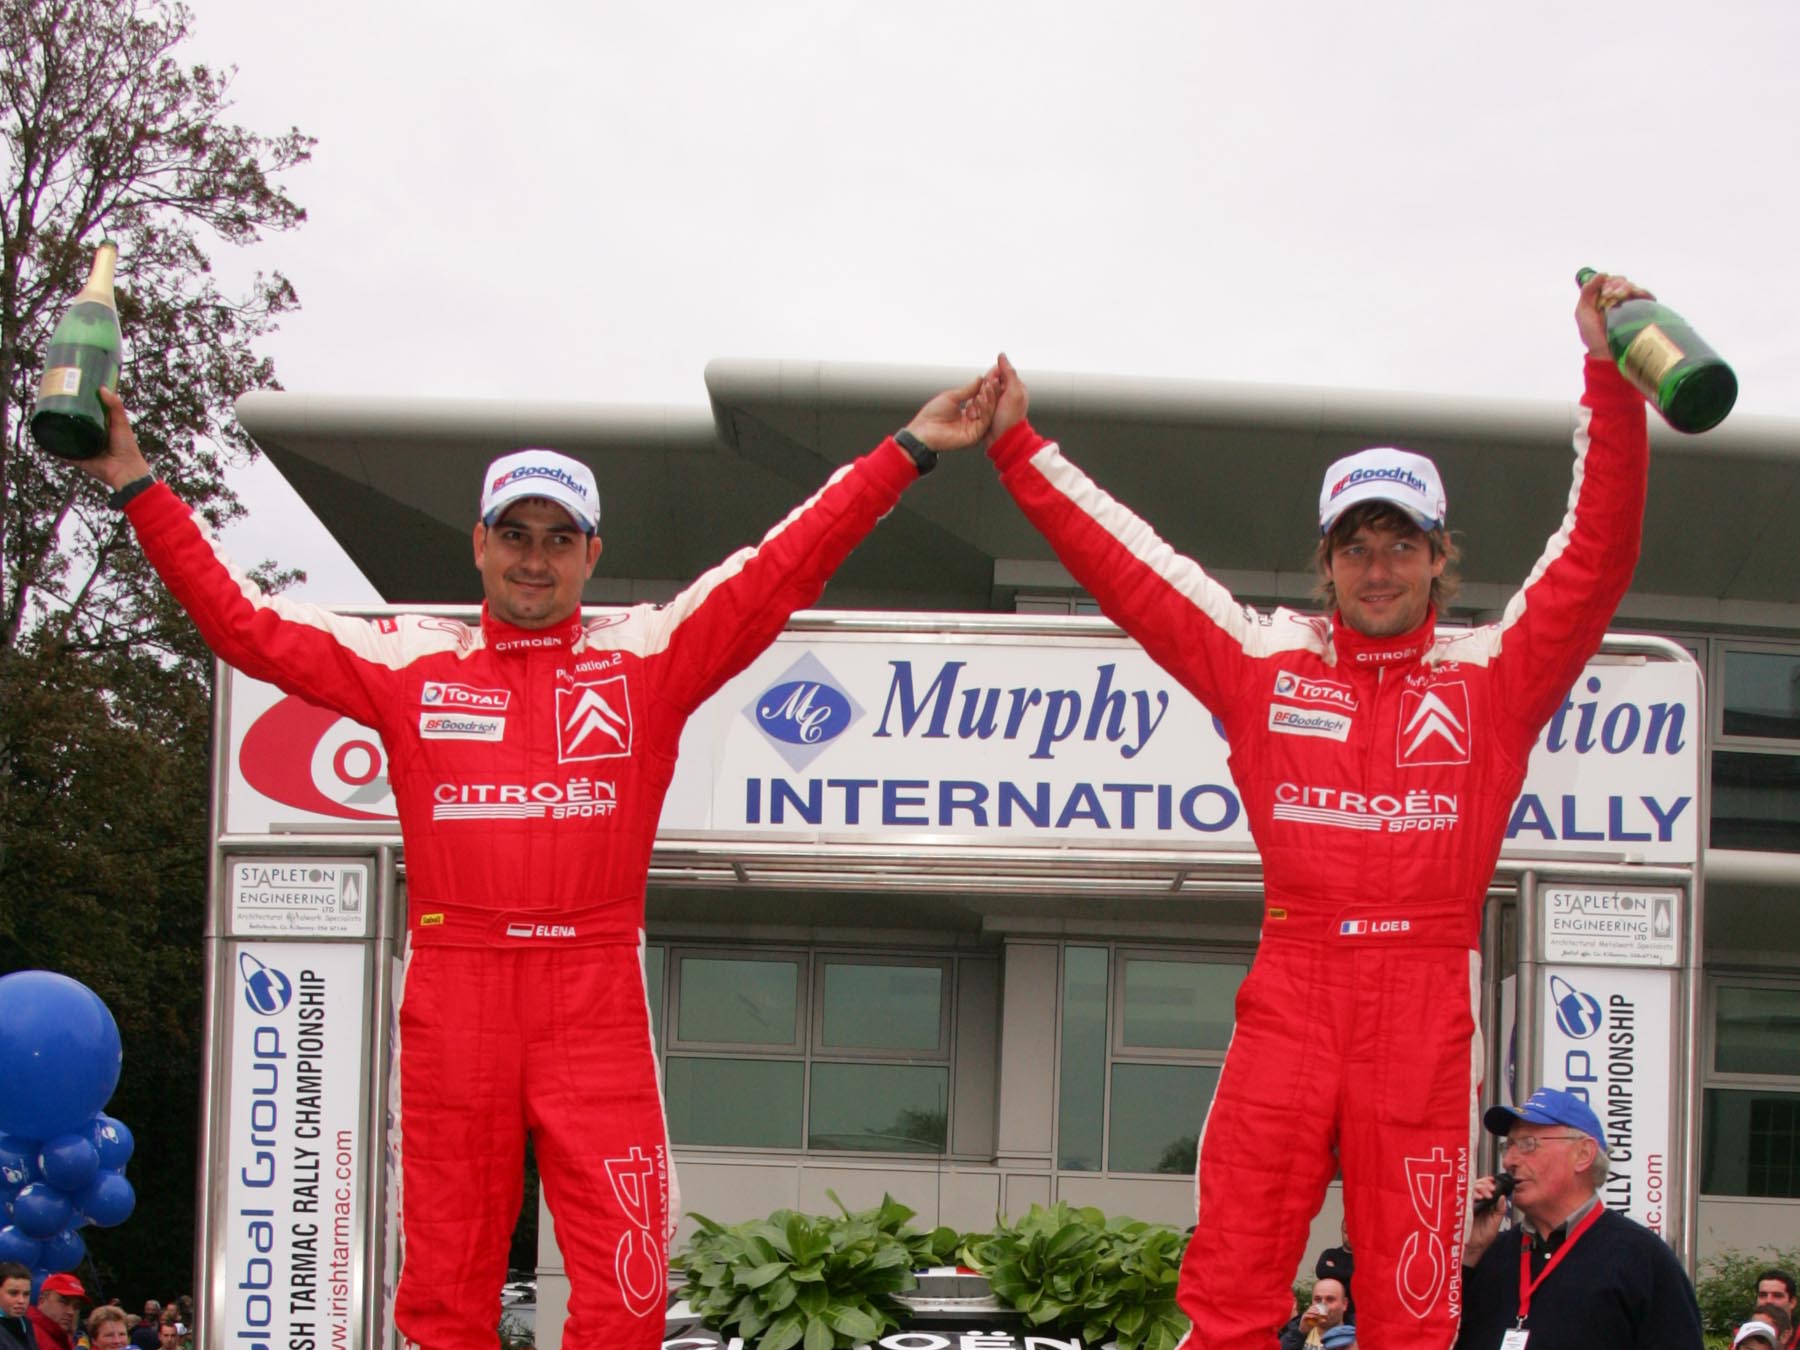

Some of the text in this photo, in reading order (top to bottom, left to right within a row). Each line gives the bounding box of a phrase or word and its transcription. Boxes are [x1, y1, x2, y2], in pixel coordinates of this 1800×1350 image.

[495, 636, 562, 651] CITROËN
[447, 687, 504, 706] TOTAL
[1301, 683, 1355, 704] TOTAL
[873, 660, 1686, 760] Murphy tion
[425, 719, 497, 733] BFGoodrich
[1274, 711, 1343, 730] BFGoodrich
[434, 778, 616, 803] CITROËN
[1275, 783, 1457, 816] CITROËN
[552, 804, 617, 820] SPORT
[746, 778, 1692, 842] INTERNATIO ALLY
[1388, 818, 1458, 832] SPORT
[241, 868, 335, 884] STAPLETON
[240, 892, 336, 905] ENGINEERING
[536, 925, 576, 938] ELENA
[1371, 921, 1410, 933] LOEB
[1553, 918, 1648, 933] ENGINEERING
[294, 969, 326, 1139] CHAMPIONSHIP
[1607, 993, 1635, 1163] CHAMPIONSHIP
[241, 1026, 287, 1188] Group
[293, 1147, 320, 1213] RALLY
[290, 1223, 319, 1314] TARMAC
